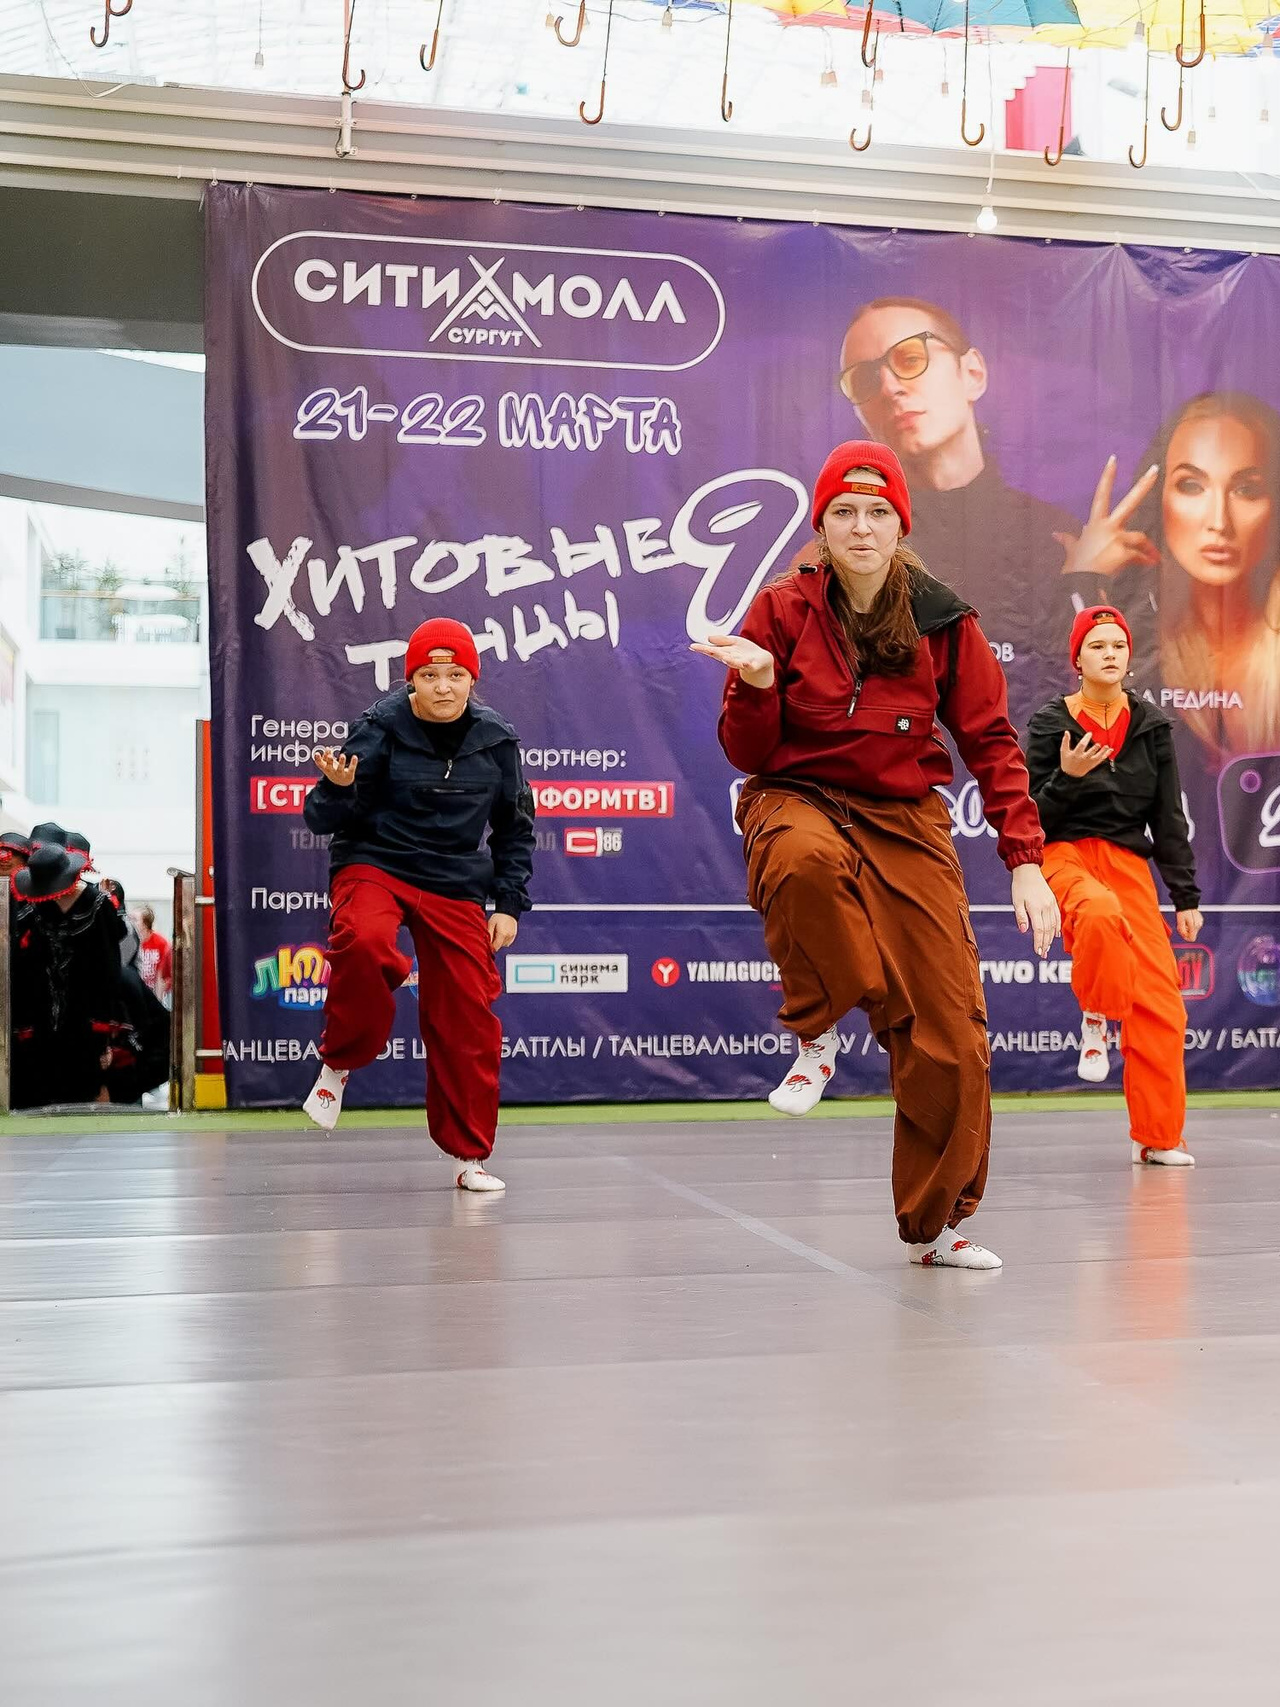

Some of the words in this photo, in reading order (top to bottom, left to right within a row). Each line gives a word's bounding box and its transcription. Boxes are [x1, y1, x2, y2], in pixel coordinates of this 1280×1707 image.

[294, 258, 460, 309] СИТИ
[512, 272, 688, 325] МОЛЛ
[447, 326, 525, 347] СУРГУТ
[293, 386, 487, 447] 21-22
[498, 391, 683, 456] МАРТА
[246, 518, 681, 642] ХИТОВЫЕ
[344, 589, 621, 693] ТНЦЫ
[1160, 687, 1244, 710] РЕДИНА
[560, 962, 620, 974] синема
[560, 973, 600, 987] парк
[687, 961, 782, 982] YAMAGUC
[979, 959, 1035, 983] TWO
[500, 1035, 585, 1058] БАТТЛЫ
[608, 1033, 794, 1059] ТАНЦЕВАЛЬНОЕ
